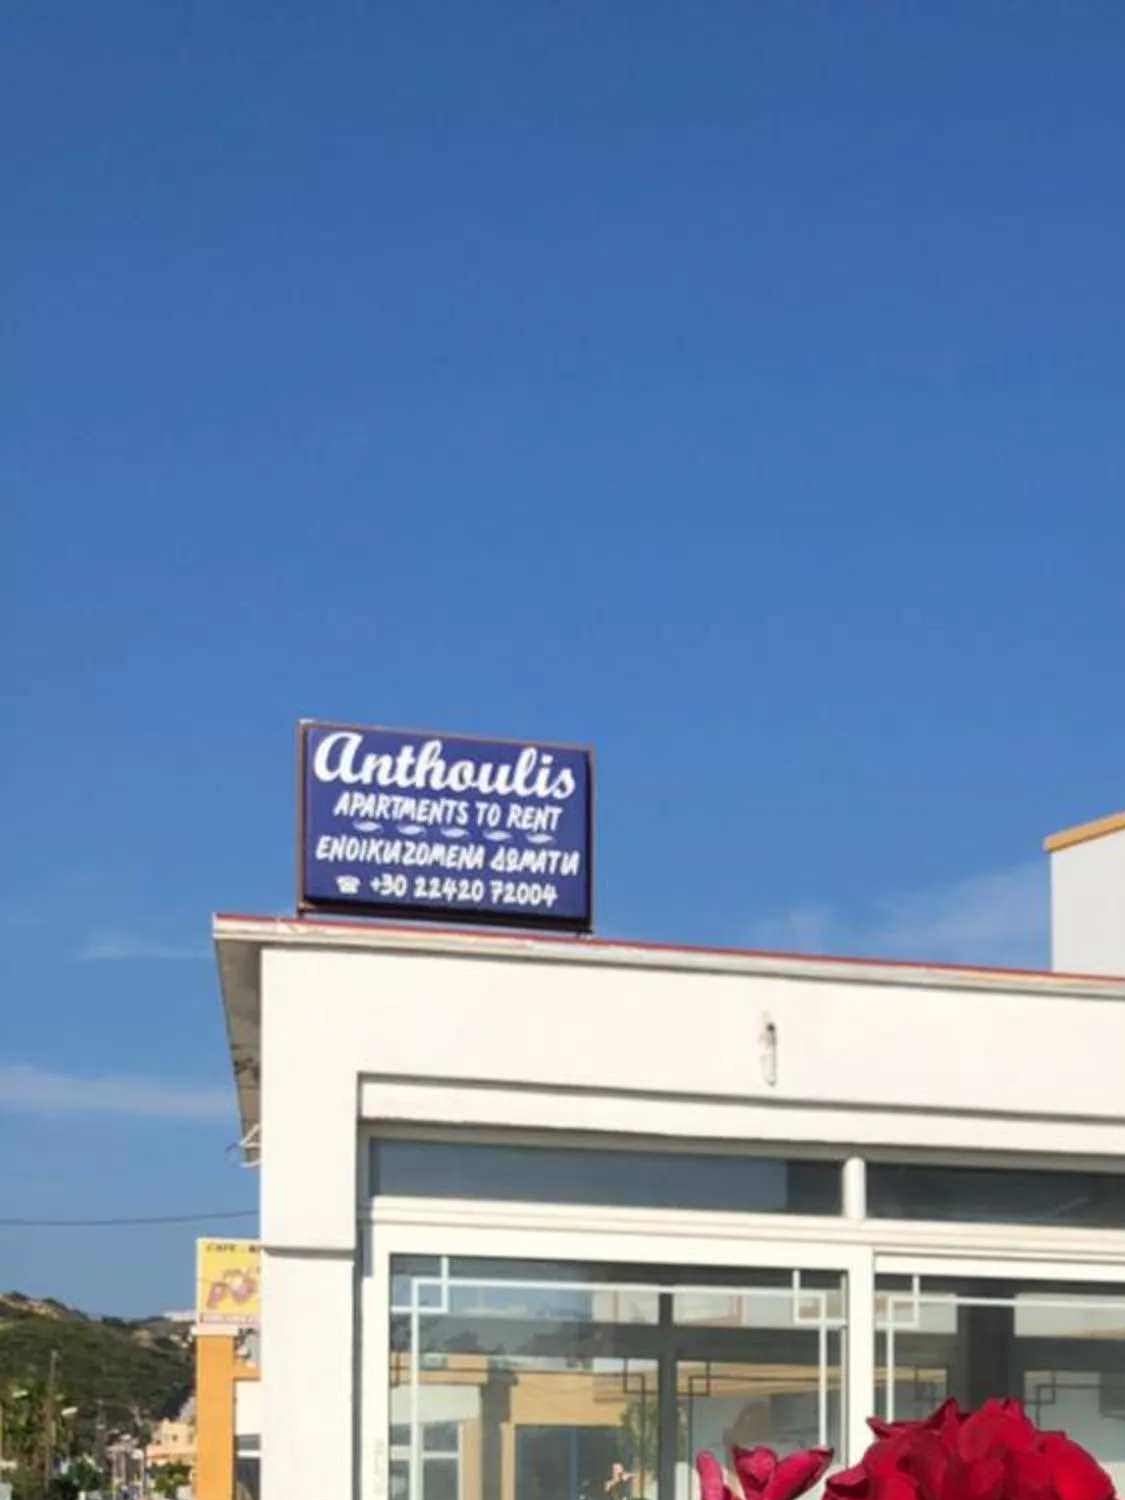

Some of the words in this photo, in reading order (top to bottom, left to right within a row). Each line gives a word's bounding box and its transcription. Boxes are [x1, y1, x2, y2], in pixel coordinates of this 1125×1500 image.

[314, 732, 576, 799] Anthoulis
[334, 792, 469, 825] APARTMENTS
[476, 801, 501, 826] TO
[506, 804, 563, 832] RENT
[370, 873, 407, 898] +30
[413, 876, 485, 902] 22420
[489, 879, 558, 907] 72004
